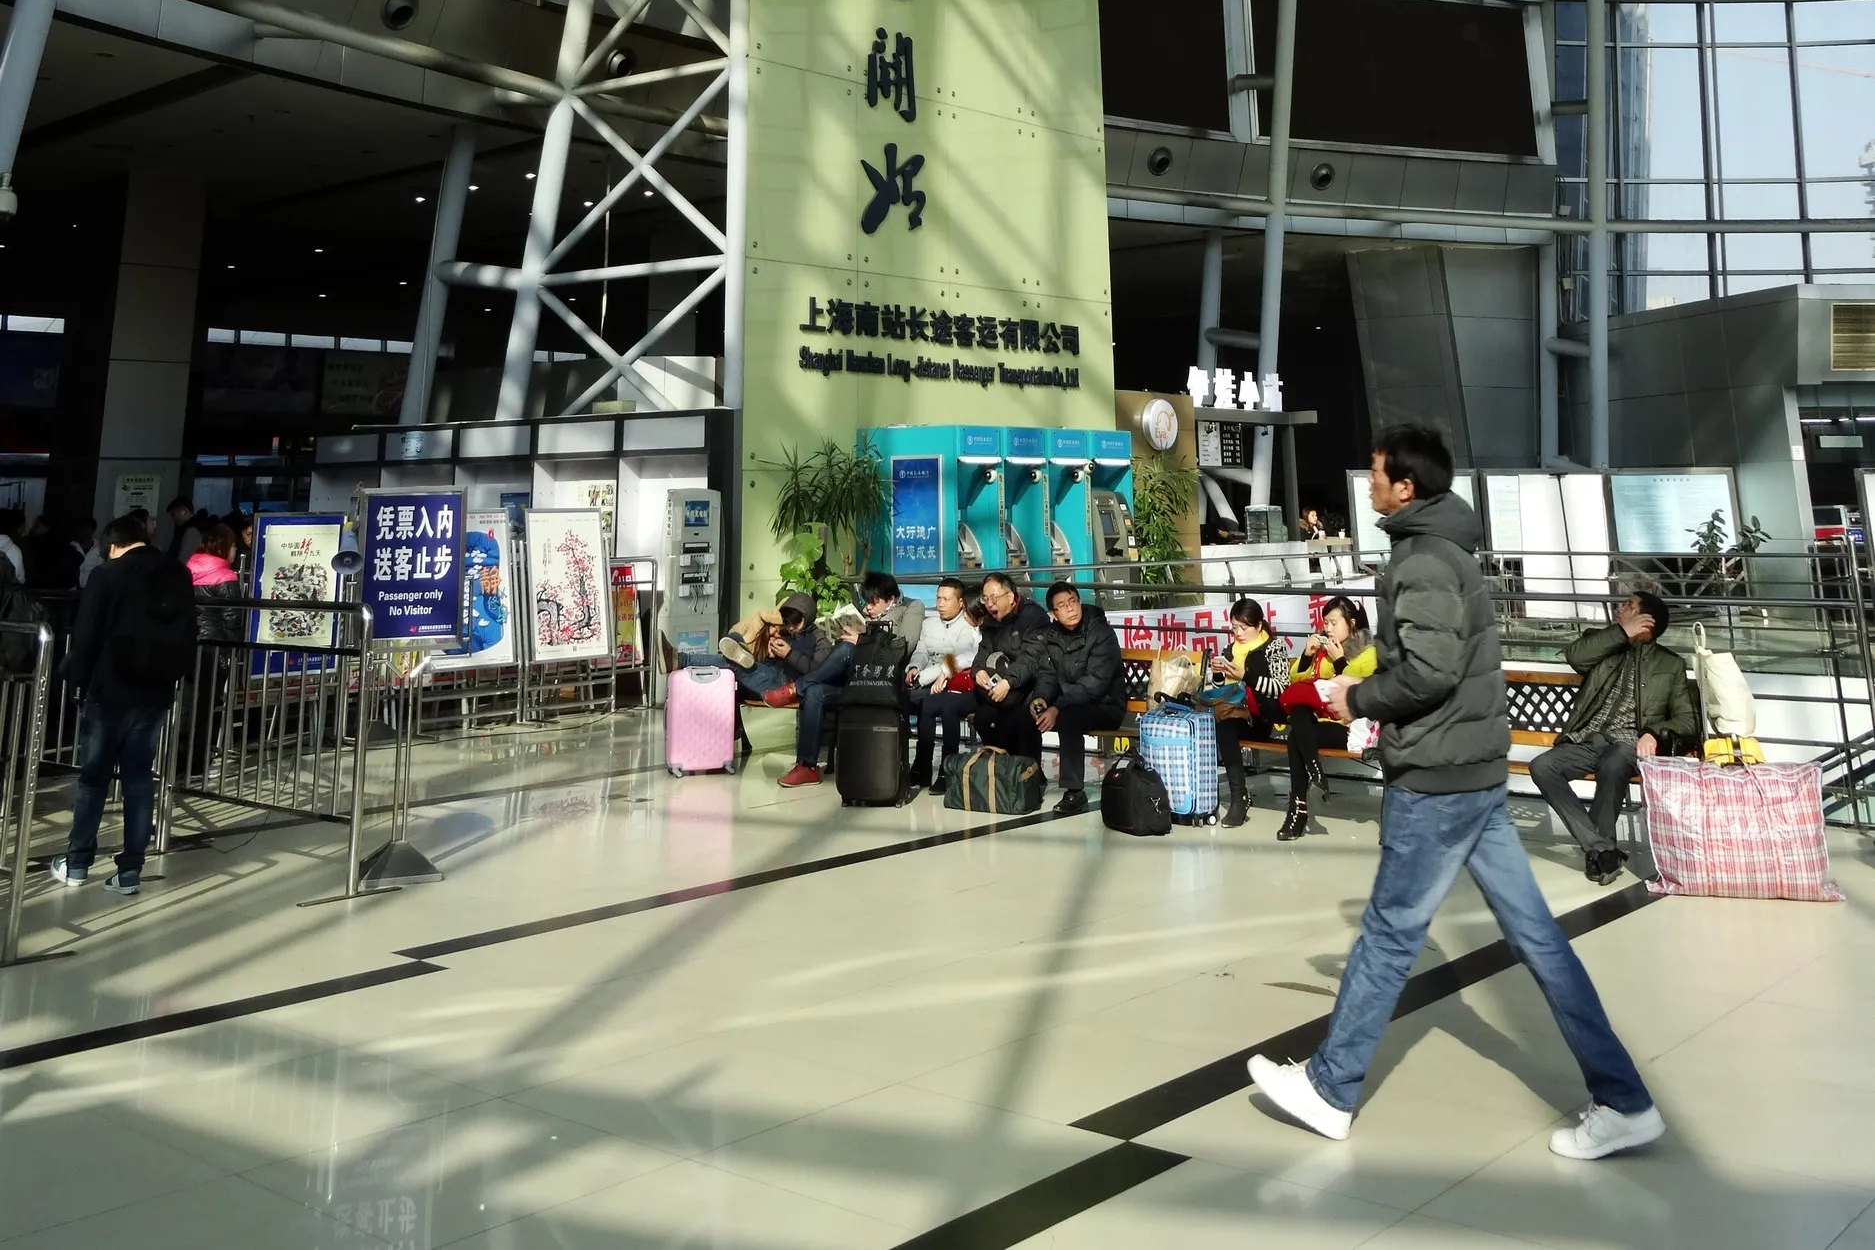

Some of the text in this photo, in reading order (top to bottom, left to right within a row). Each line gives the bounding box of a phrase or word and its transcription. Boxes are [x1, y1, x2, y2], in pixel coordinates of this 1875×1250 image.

[799, 297, 1080, 356] 上海南站长途客运有限公司
[799, 345, 843, 376] Shanghai
[953, 358, 995, 388] Passenger
[375, 504, 454, 541] 凭票入内
[896, 525, 937, 540] 大行德广
[373, 544, 454, 581] 送客止步
[896, 544, 937, 560] 伴您成长
[378, 589, 443, 602] Passenger only
[389, 605, 433, 616] No Visitor
